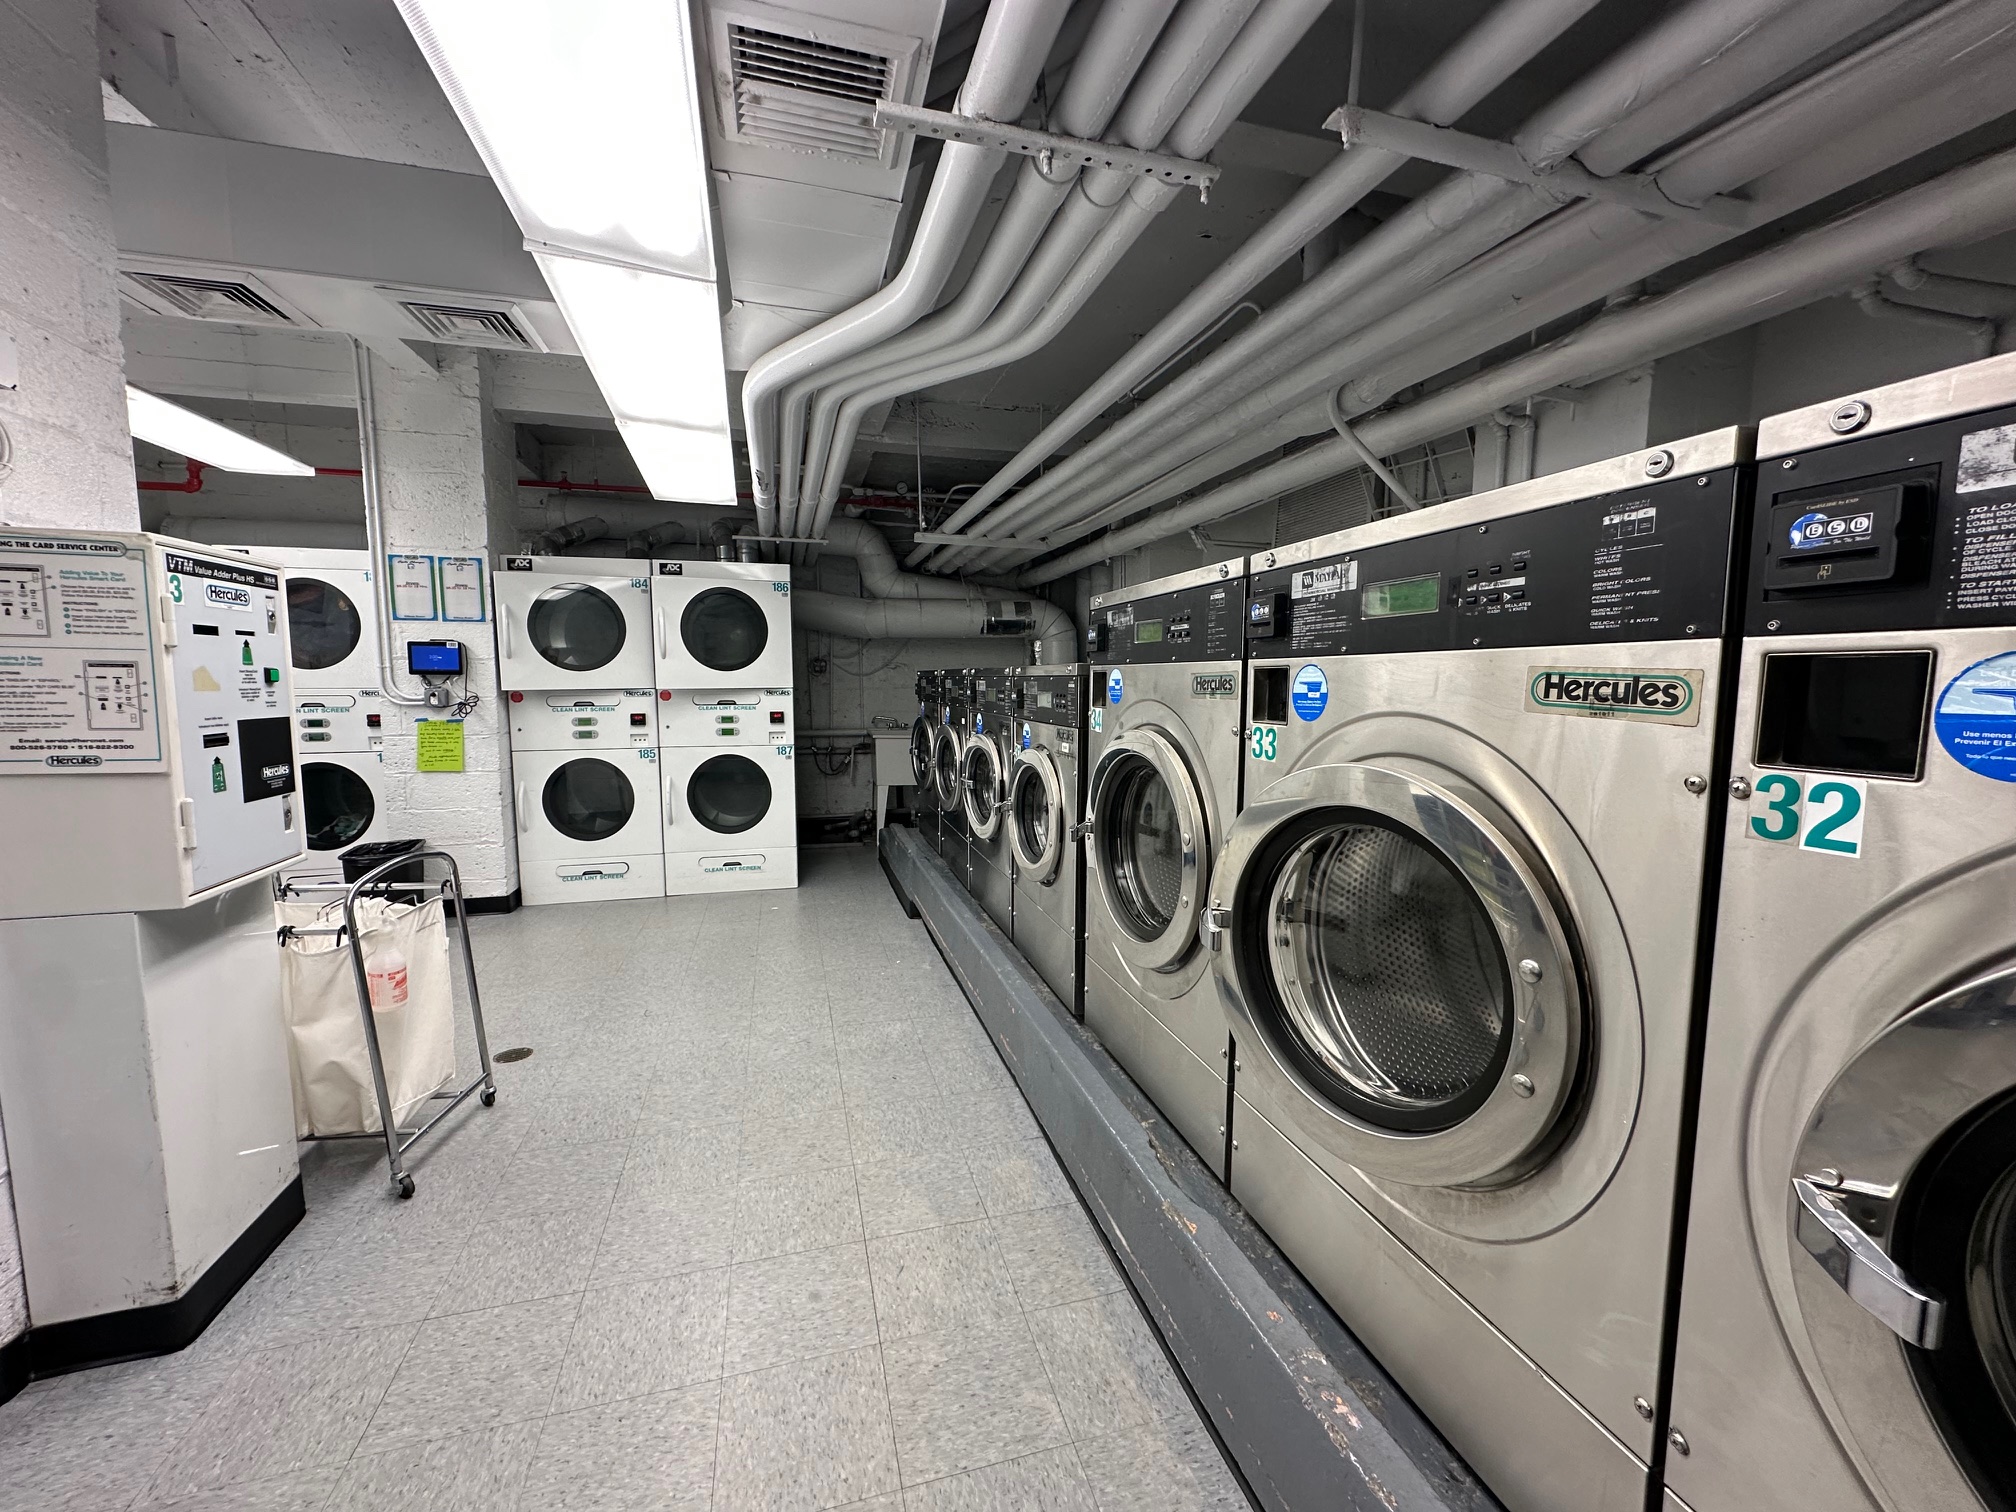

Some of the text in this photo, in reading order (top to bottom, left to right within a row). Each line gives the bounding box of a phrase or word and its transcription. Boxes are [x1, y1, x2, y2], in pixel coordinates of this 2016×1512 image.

[1969, 506, 1988, 514] TO
[1966, 512, 1994, 521] OPEN
[1806, 517, 1869, 538] ESD
[1966, 519, 1994, 528] LOAD
[1965, 525, 1999, 534] CLOSE
[1965, 536, 1984, 544] TO
[15, 541, 31, 549] THE
[56, 543, 87, 551] SERVICE
[89, 544, 119, 552] CENTER
[1961, 558, 2001, 567] BLEACH
[168, 556, 194, 573] VTM
[194, 566, 212, 576] Value
[213, 569, 232, 580] Adder
[232, 572, 245, 582] Plus
[246, 575, 255, 584] HS
[1593, 567, 1623, 575] COLORS
[1961, 564, 1999, 572] DURING
[629, 578, 649, 589] 184
[772, 582, 789, 593] 186
[170, 574, 183, 604] 3
[210, 585, 248, 603] Hercules
[1957, 588, 1993, 596] INSERT
[1195, 676, 1233, 691] Hercules
[1543, 673, 1679, 708] Hercules
[1091, 708, 1102, 731] 34
[1962, 730, 1980, 738] Use
[1252, 726, 1277, 761] 33
[1954, 738, 1991, 746] Prevenir
[637, 749, 656, 759] 185
[775, 746, 793, 756] 187
[50, 755, 99, 765] Hercules
[262, 764, 290, 779] Hercules
[1751, 774, 1861, 854] 32
